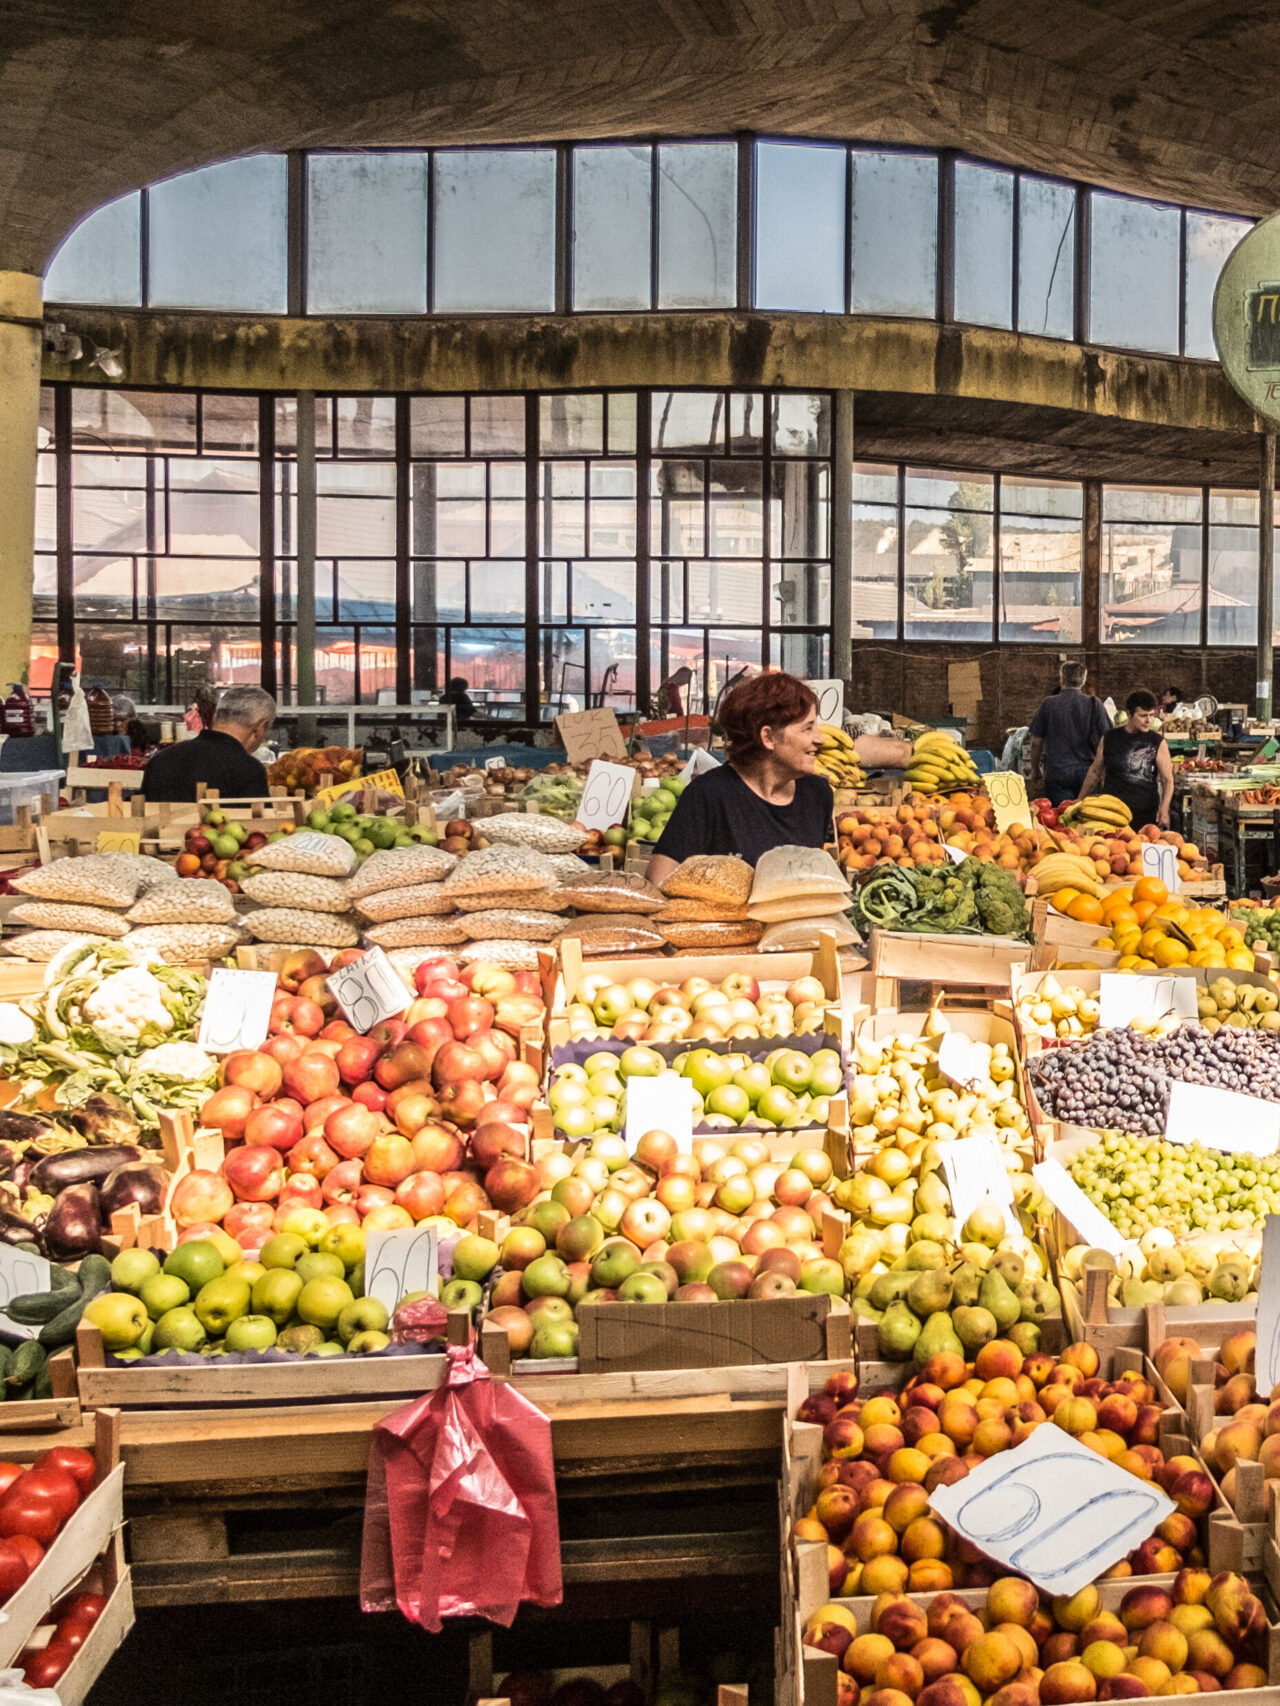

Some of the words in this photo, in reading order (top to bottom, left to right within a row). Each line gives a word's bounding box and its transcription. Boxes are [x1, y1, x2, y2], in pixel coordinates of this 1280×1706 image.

[584, 771, 626, 817] 60
[991, 777, 1022, 808] 60
[367, 1229, 432, 1320] 60
[956, 1451, 1160, 1580] 60
